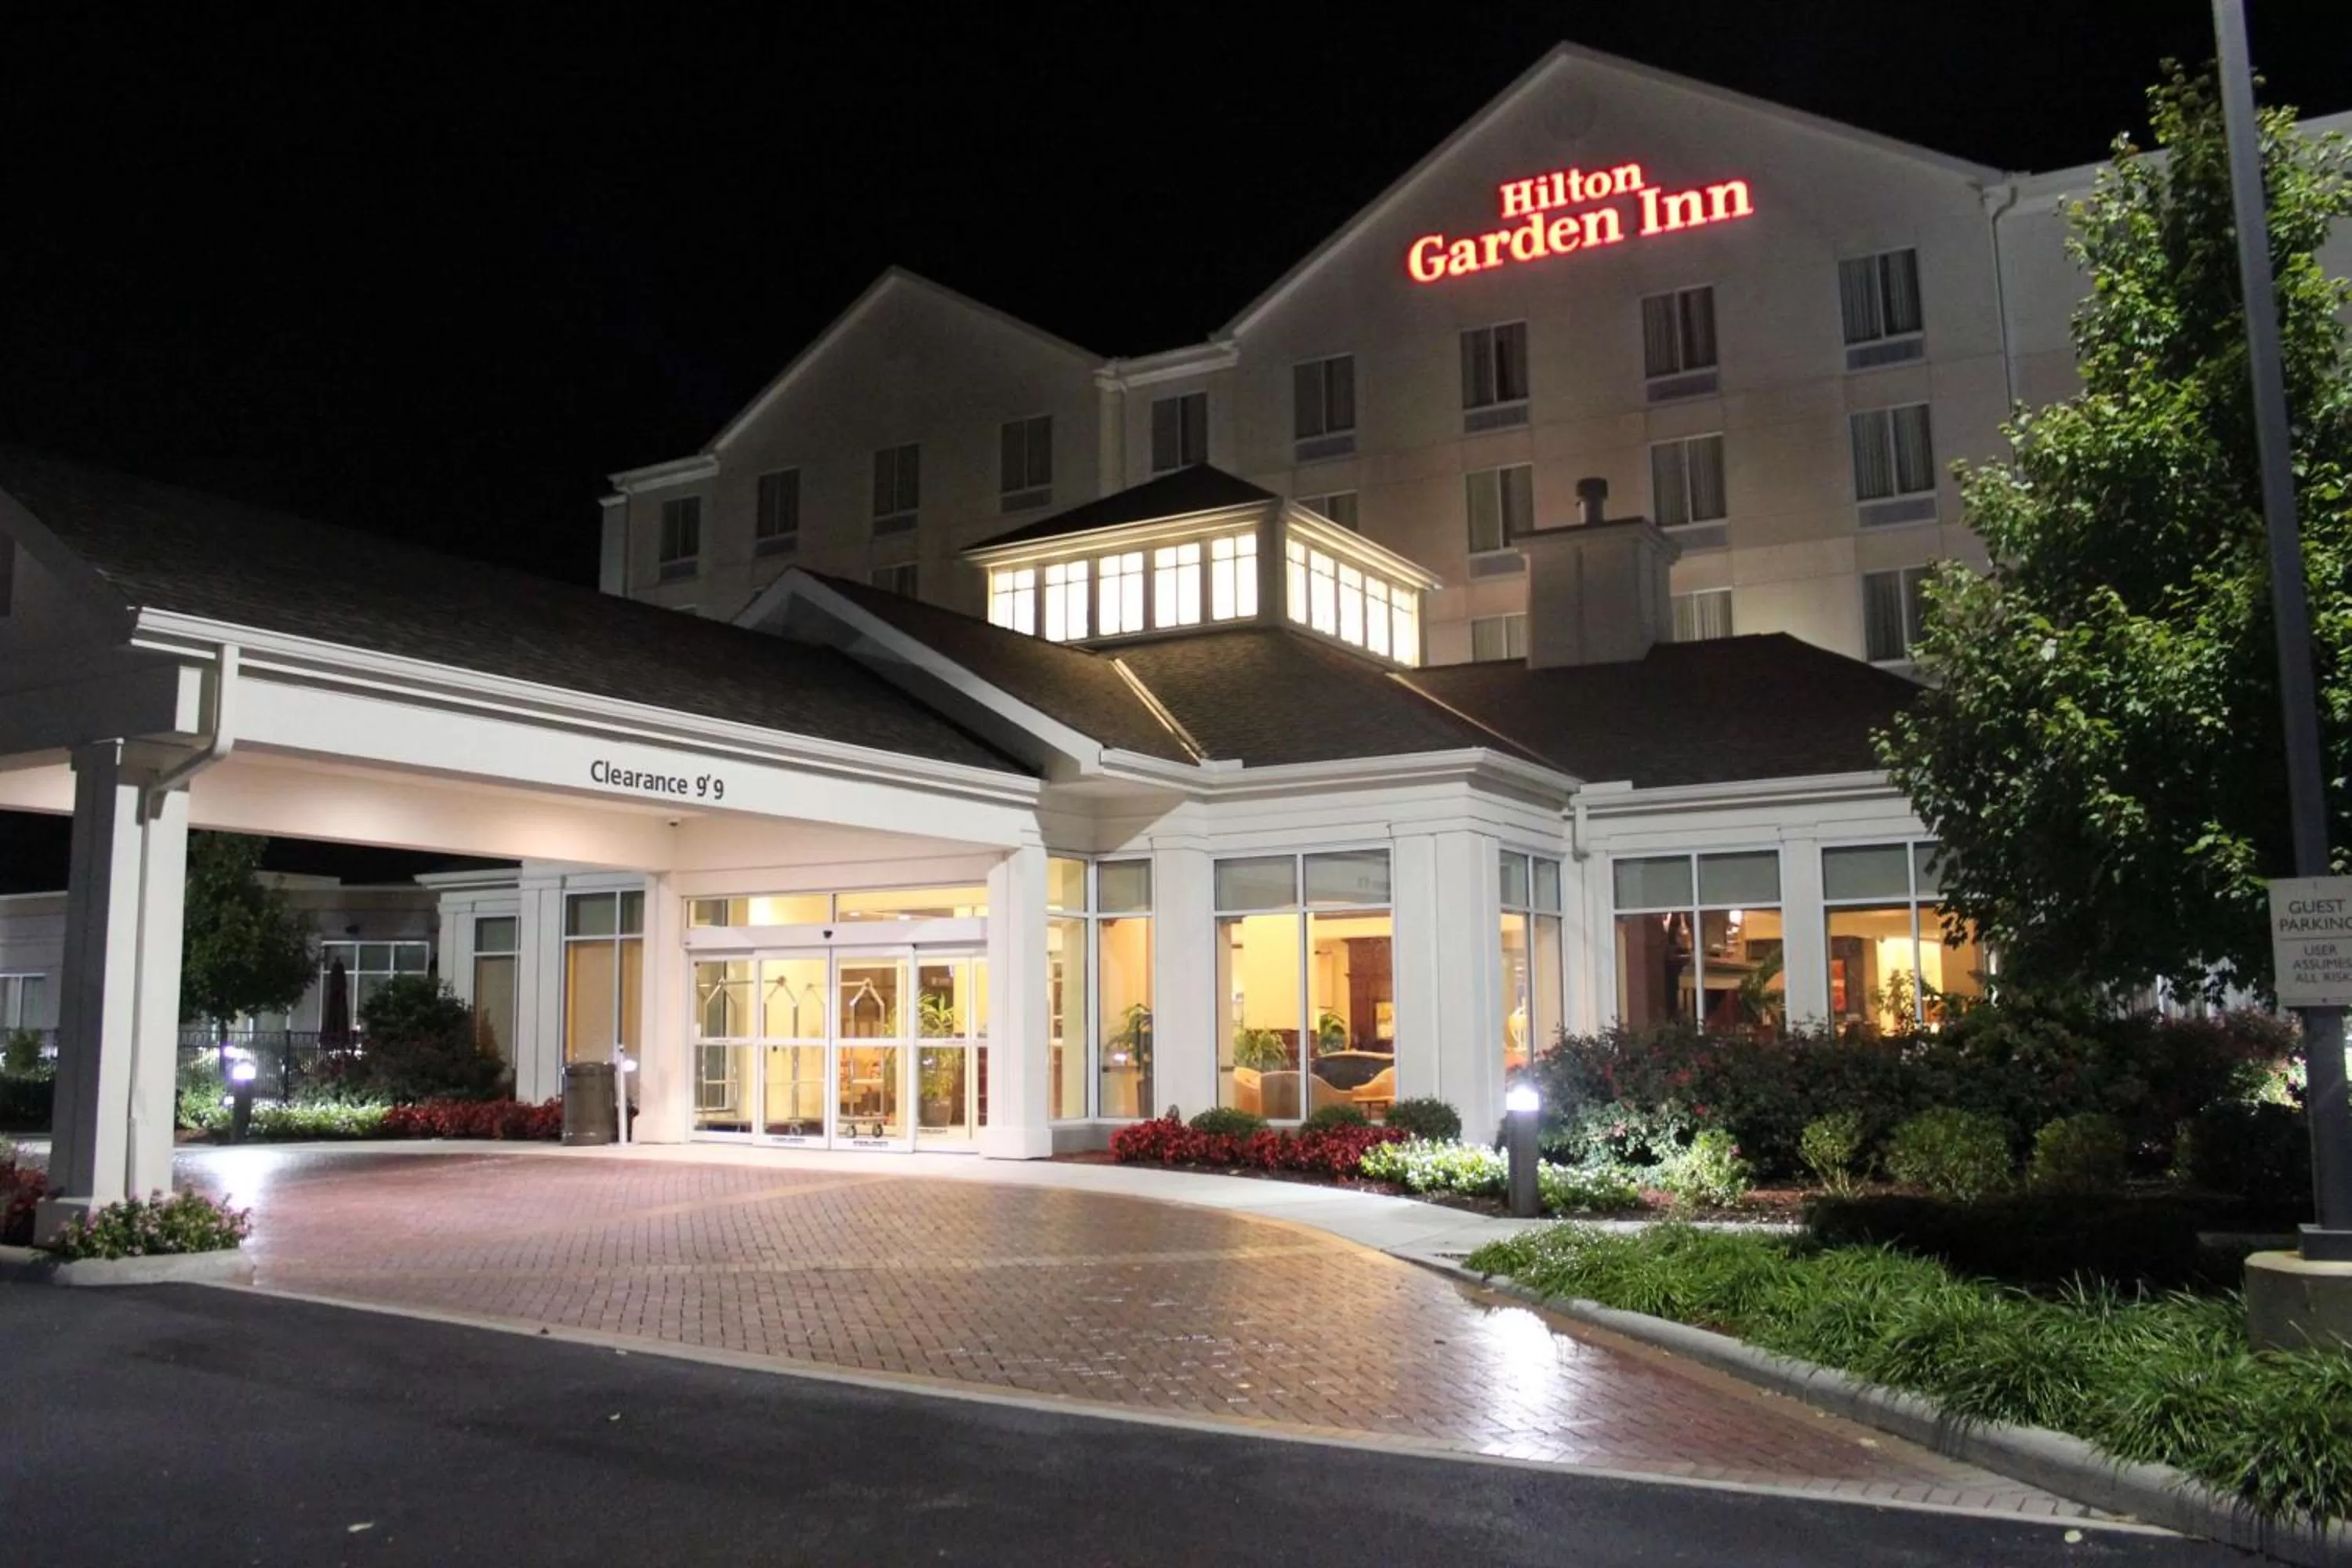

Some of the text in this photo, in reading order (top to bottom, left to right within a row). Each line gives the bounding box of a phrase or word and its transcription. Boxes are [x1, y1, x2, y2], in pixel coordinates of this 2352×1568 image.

[1500, 162, 1646, 219] Hilton
[1407, 178, 1754, 283] Garden Inn
[590, 760, 724, 800] Clearance 9'9
[2288, 898, 2346, 915] GUEST
[2304, 943, 2338, 956] USER
[2292, 956, 2352, 970] ASSUMES
[2295, 972, 2318, 984] ALL
